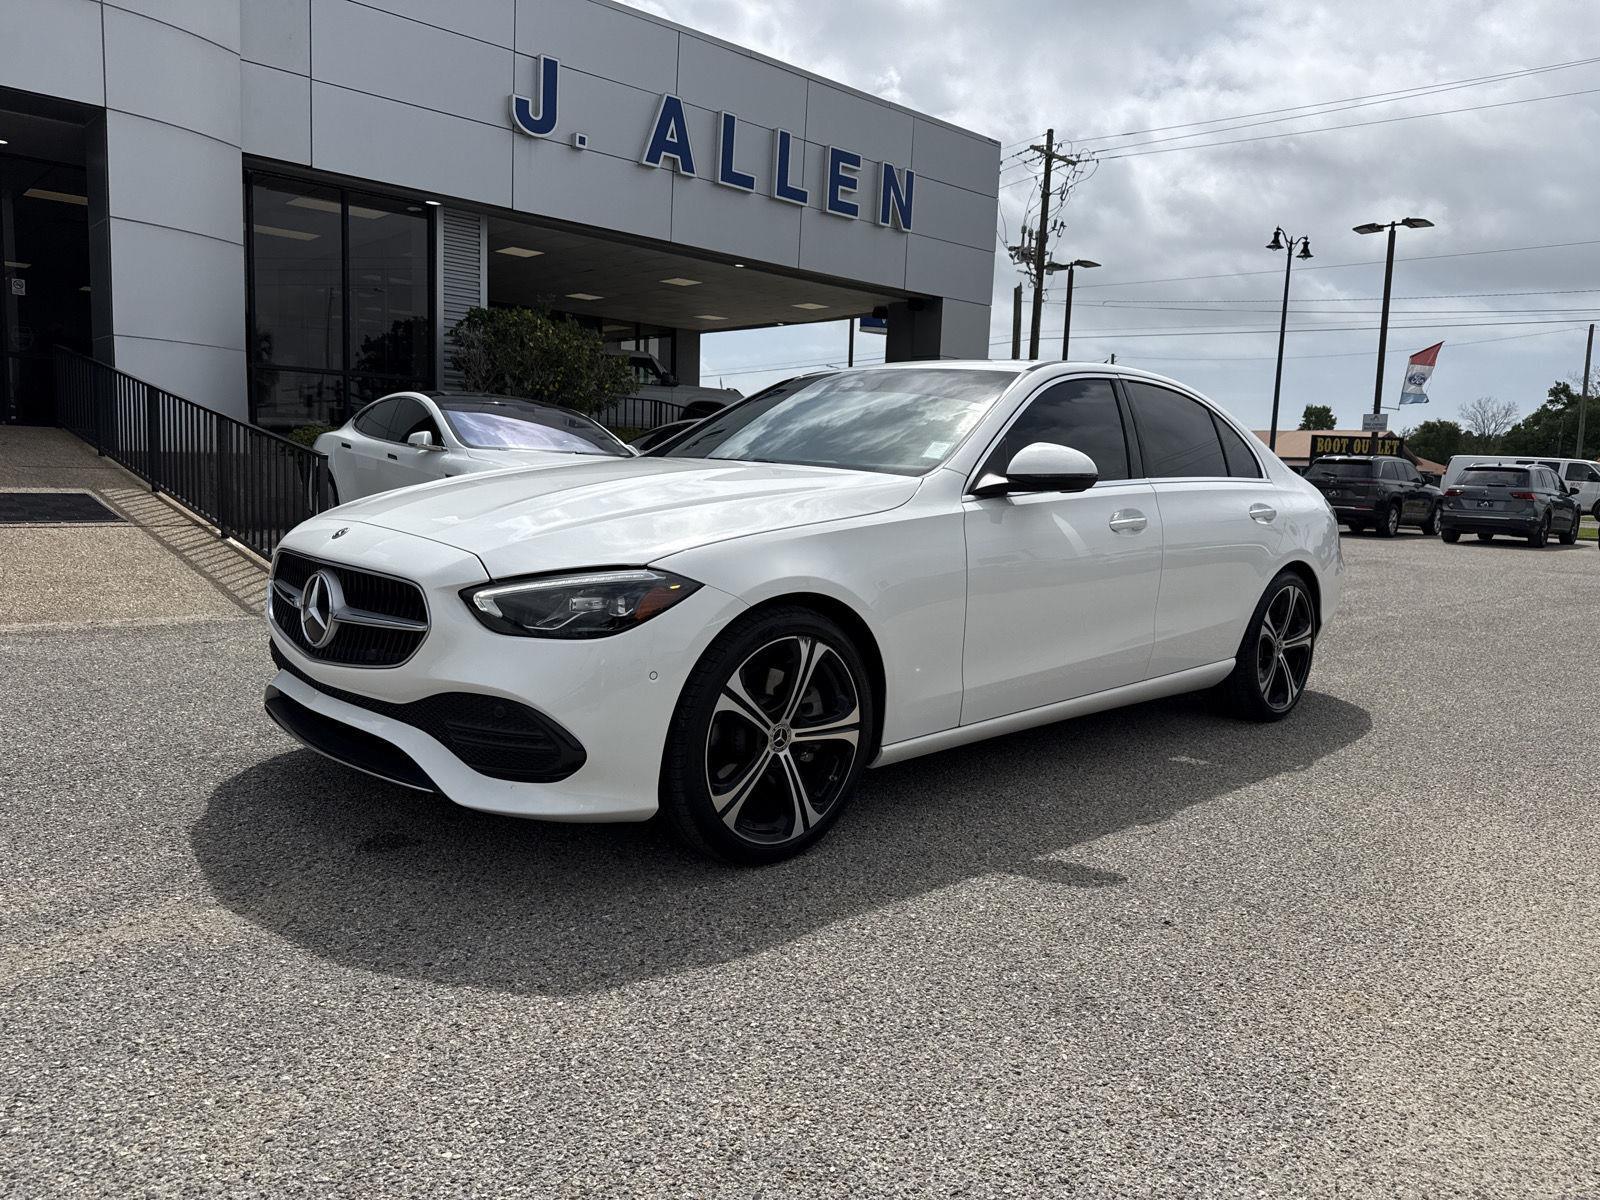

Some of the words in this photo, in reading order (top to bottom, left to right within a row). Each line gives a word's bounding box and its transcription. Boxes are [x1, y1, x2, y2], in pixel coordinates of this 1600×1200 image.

[509, 54, 588, 150] J.
[639, 92, 916, 233] ALLEN
[1316, 437, 1349, 453] BOOT
[1353, 438, 1400, 455] OULET
